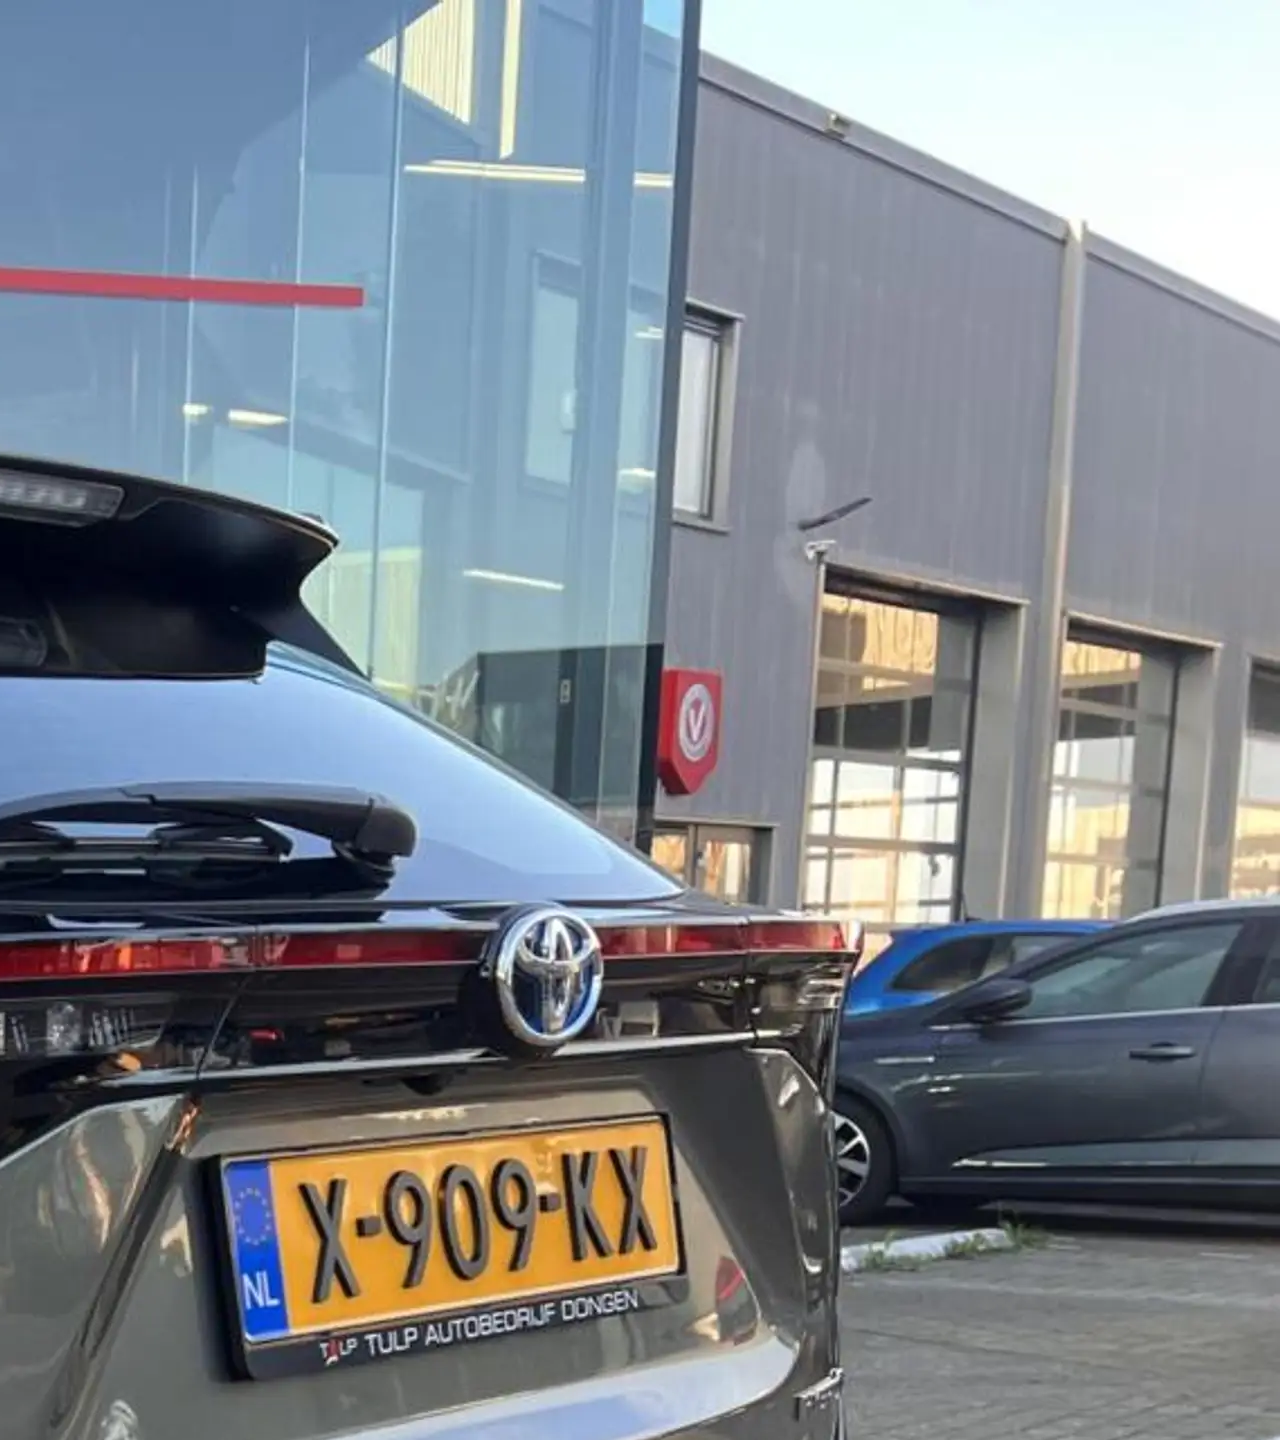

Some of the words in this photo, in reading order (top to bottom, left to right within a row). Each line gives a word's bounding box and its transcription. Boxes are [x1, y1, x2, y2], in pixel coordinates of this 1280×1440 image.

[242, 1272, 281, 1309] NL
[298, 1145, 658, 1304] X-909-KX
[364, 1327, 418, 1356] TULP
[425, 1302, 555, 1347] AUTOBEDRIJF
[561, 1289, 639, 1321] DONGEN
